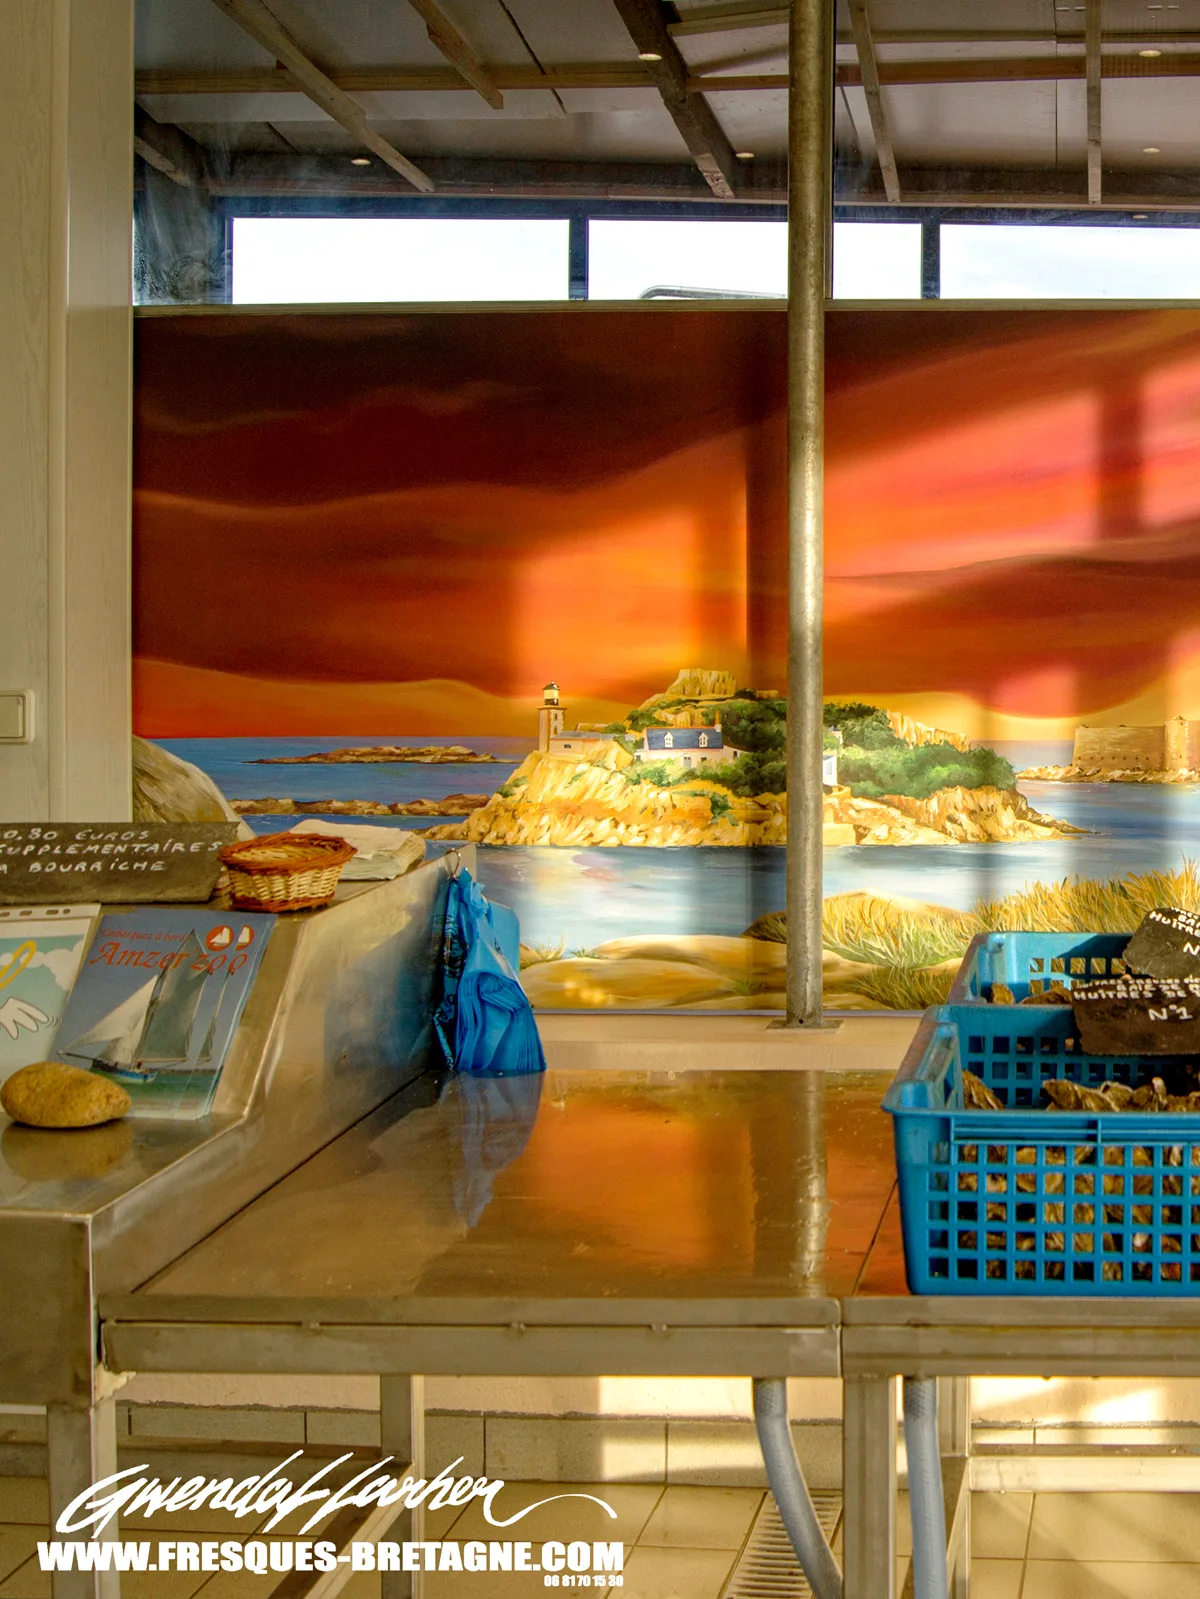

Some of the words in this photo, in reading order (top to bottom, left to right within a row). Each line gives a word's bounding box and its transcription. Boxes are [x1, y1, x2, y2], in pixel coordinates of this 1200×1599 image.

[3, 827, 58, 841] 0.80
[75, 829, 150, 842] EUROS
[100, 927, 151, 941] Embarquez
[164, 932, 187, 942] bord
